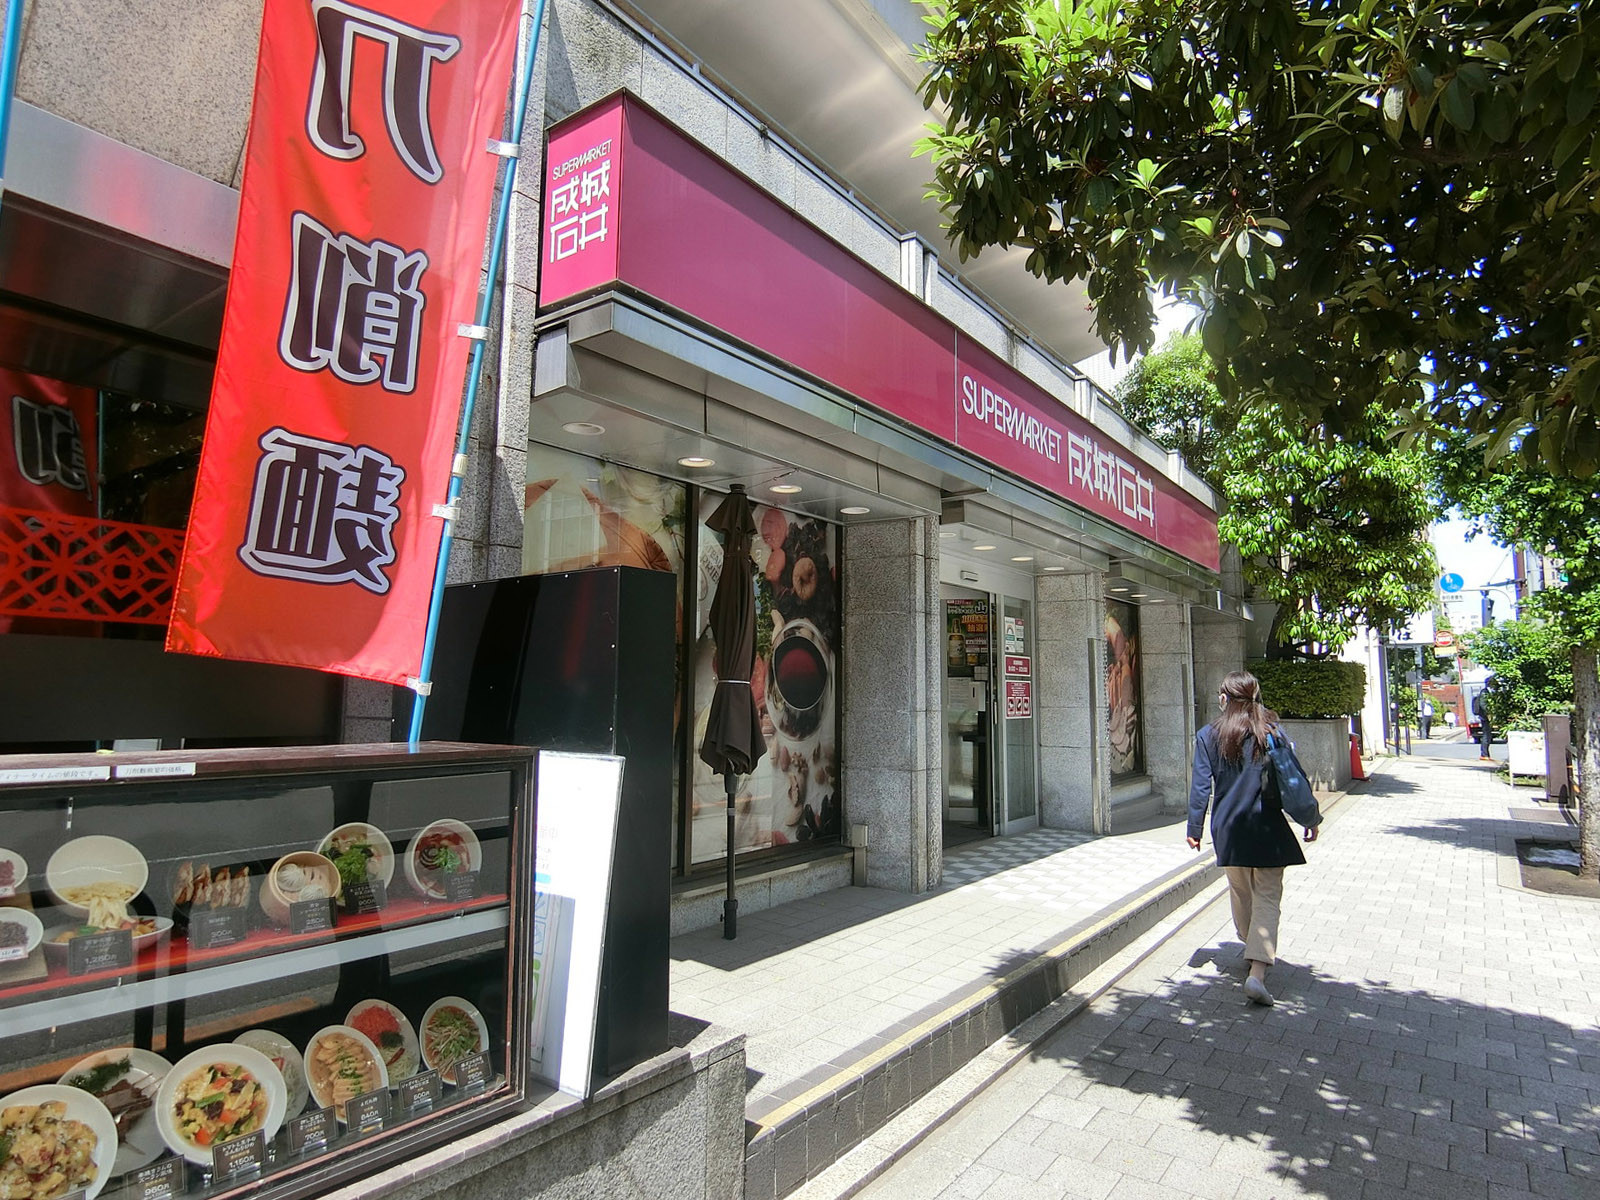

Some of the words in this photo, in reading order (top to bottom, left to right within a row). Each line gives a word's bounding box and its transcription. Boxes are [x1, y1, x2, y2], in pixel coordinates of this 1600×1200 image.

[551, 159, 610, 223] 成城
[552, 139, 612, 181] SUPERMARKET
[550, 202, 608, 263] 石井
[962, 375, 1062, 464] SUPERMARKET
[1067, 431, 1155, 528] 成城石井
